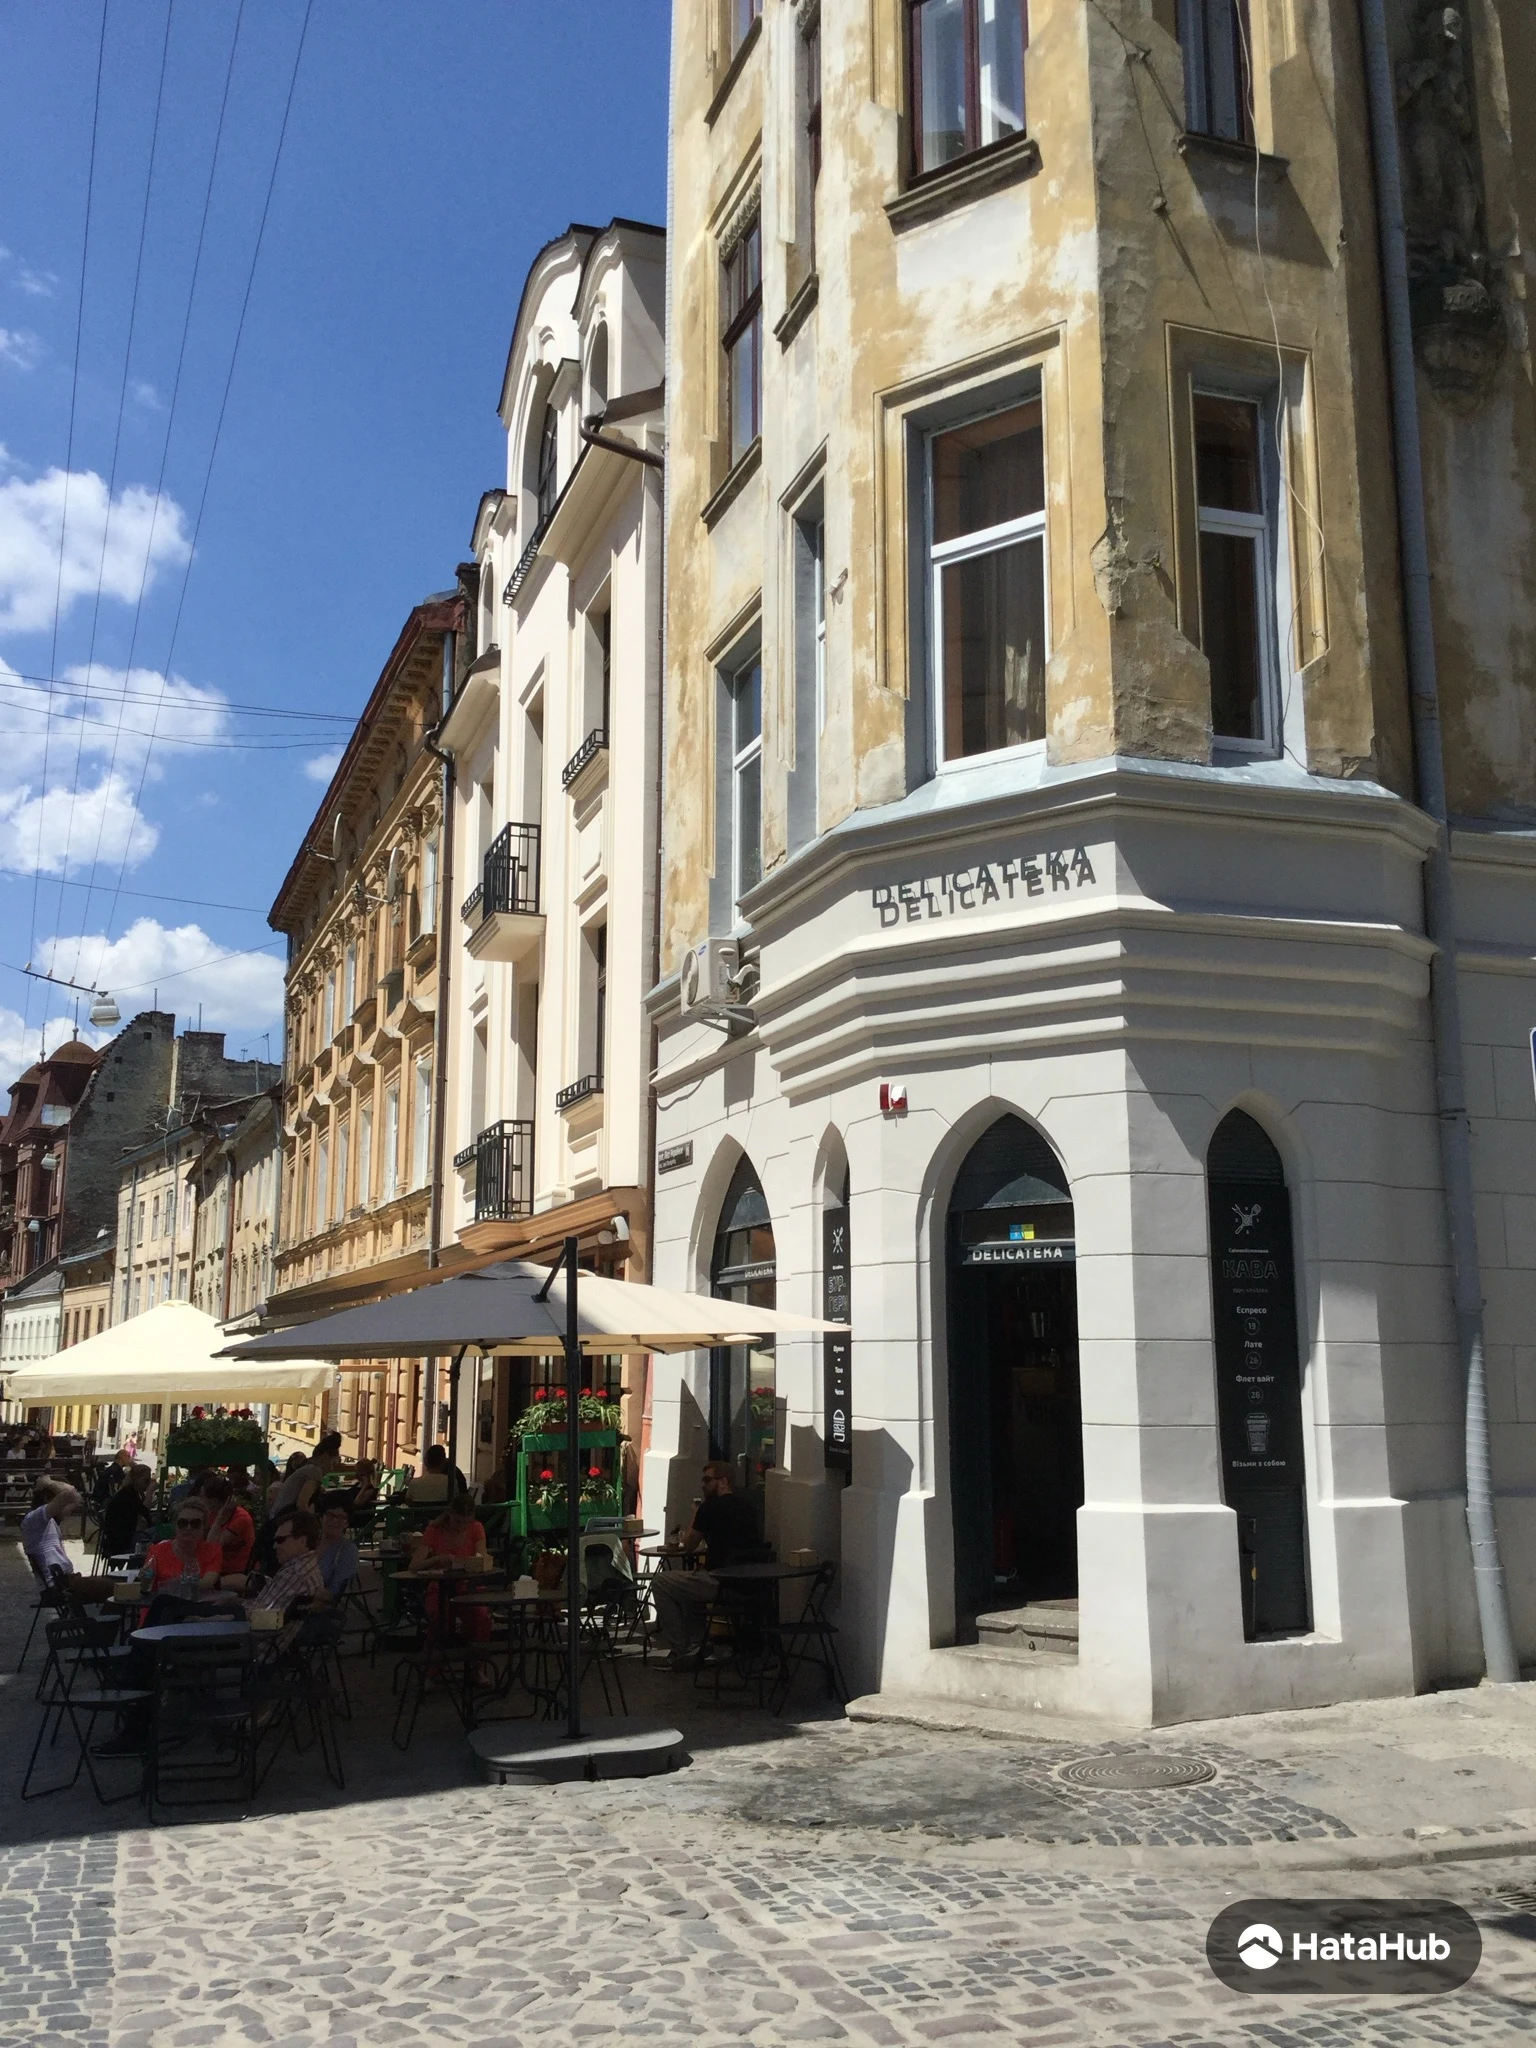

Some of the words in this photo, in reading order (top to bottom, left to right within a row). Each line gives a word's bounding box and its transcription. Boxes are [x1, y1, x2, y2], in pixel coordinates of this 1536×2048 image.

[872, 846, 1092, 910] DELICATEKA
[972, 1246, 1063, 1261] DELICATEKA
[1222, 1259, 1280, 1280] КАВА
[1236, 1306, 1267, 1315] Еспресо
[1248, 1322, 1257, 1330] 19
[1244, 1340, 1263, 1348] Лате
[1235, 1375, 1255, 1383] Флет
[1257, 1375, 1275, 1383] вайт
